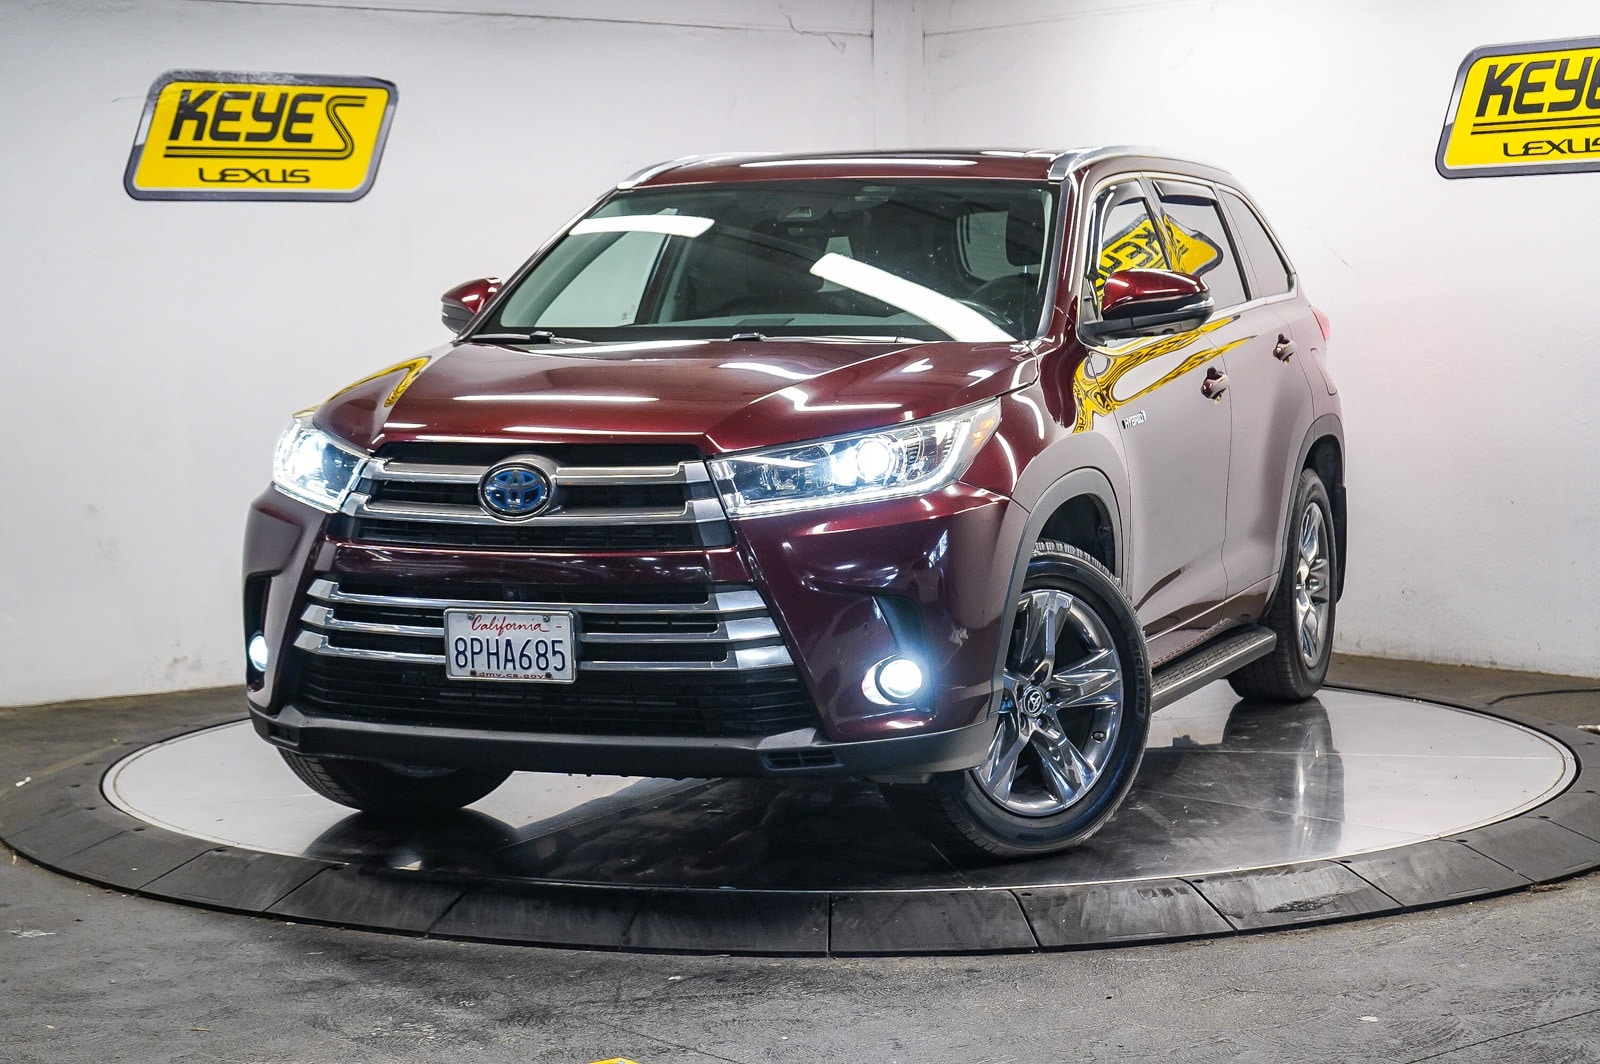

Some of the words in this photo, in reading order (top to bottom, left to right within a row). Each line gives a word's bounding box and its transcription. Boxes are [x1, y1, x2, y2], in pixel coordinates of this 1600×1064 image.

[164, 89, 367, 160] KEYES
[199, 168, 310, 183] LEXUS
[471, 615, 550, 636] California
[455, 637, 566, 672] 8PHA685
